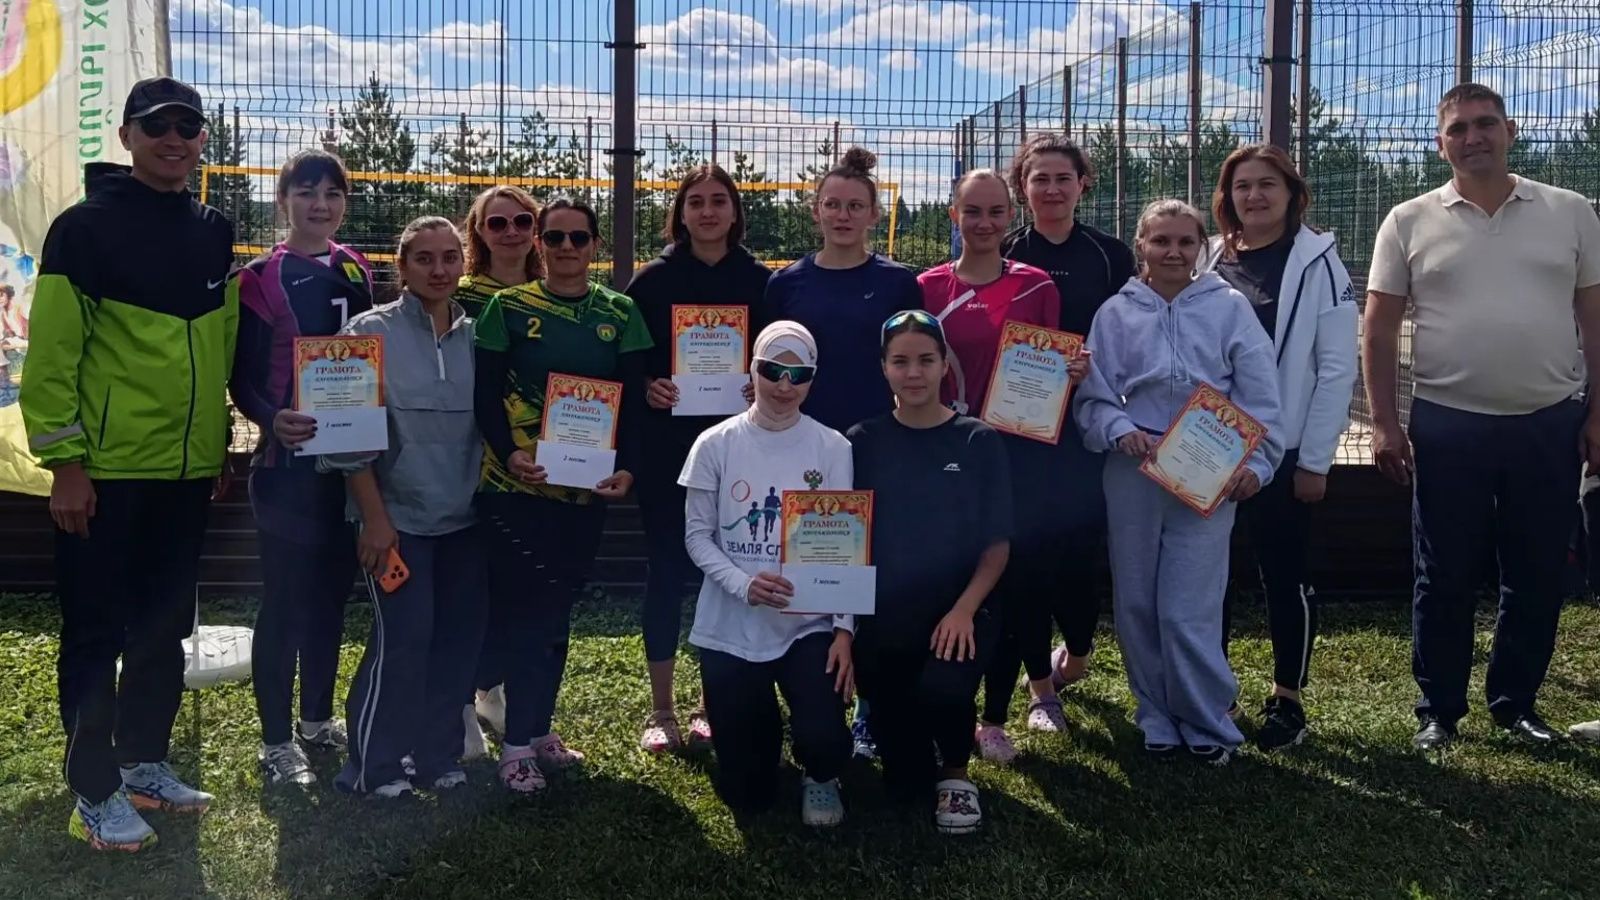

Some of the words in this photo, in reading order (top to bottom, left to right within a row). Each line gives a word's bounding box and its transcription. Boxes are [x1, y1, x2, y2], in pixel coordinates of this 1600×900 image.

[331, 297, 349, 327] 7
[527, 317, 542, 339] 2
[690, 332, 730, 340] ГРАМОТА
[1015, 350, 1057, 366] ГРАМОТА
[315, 366, 362, 375] ГРАМОТА
[562, 402, 601, 415] ГРАМОТА
[1198, 415, 1235, 446] ГРАМОТА
[802, 520, 850, 529] ГРАМОТА
[726, 540, 762, 555] ЗЕМЛЯ
